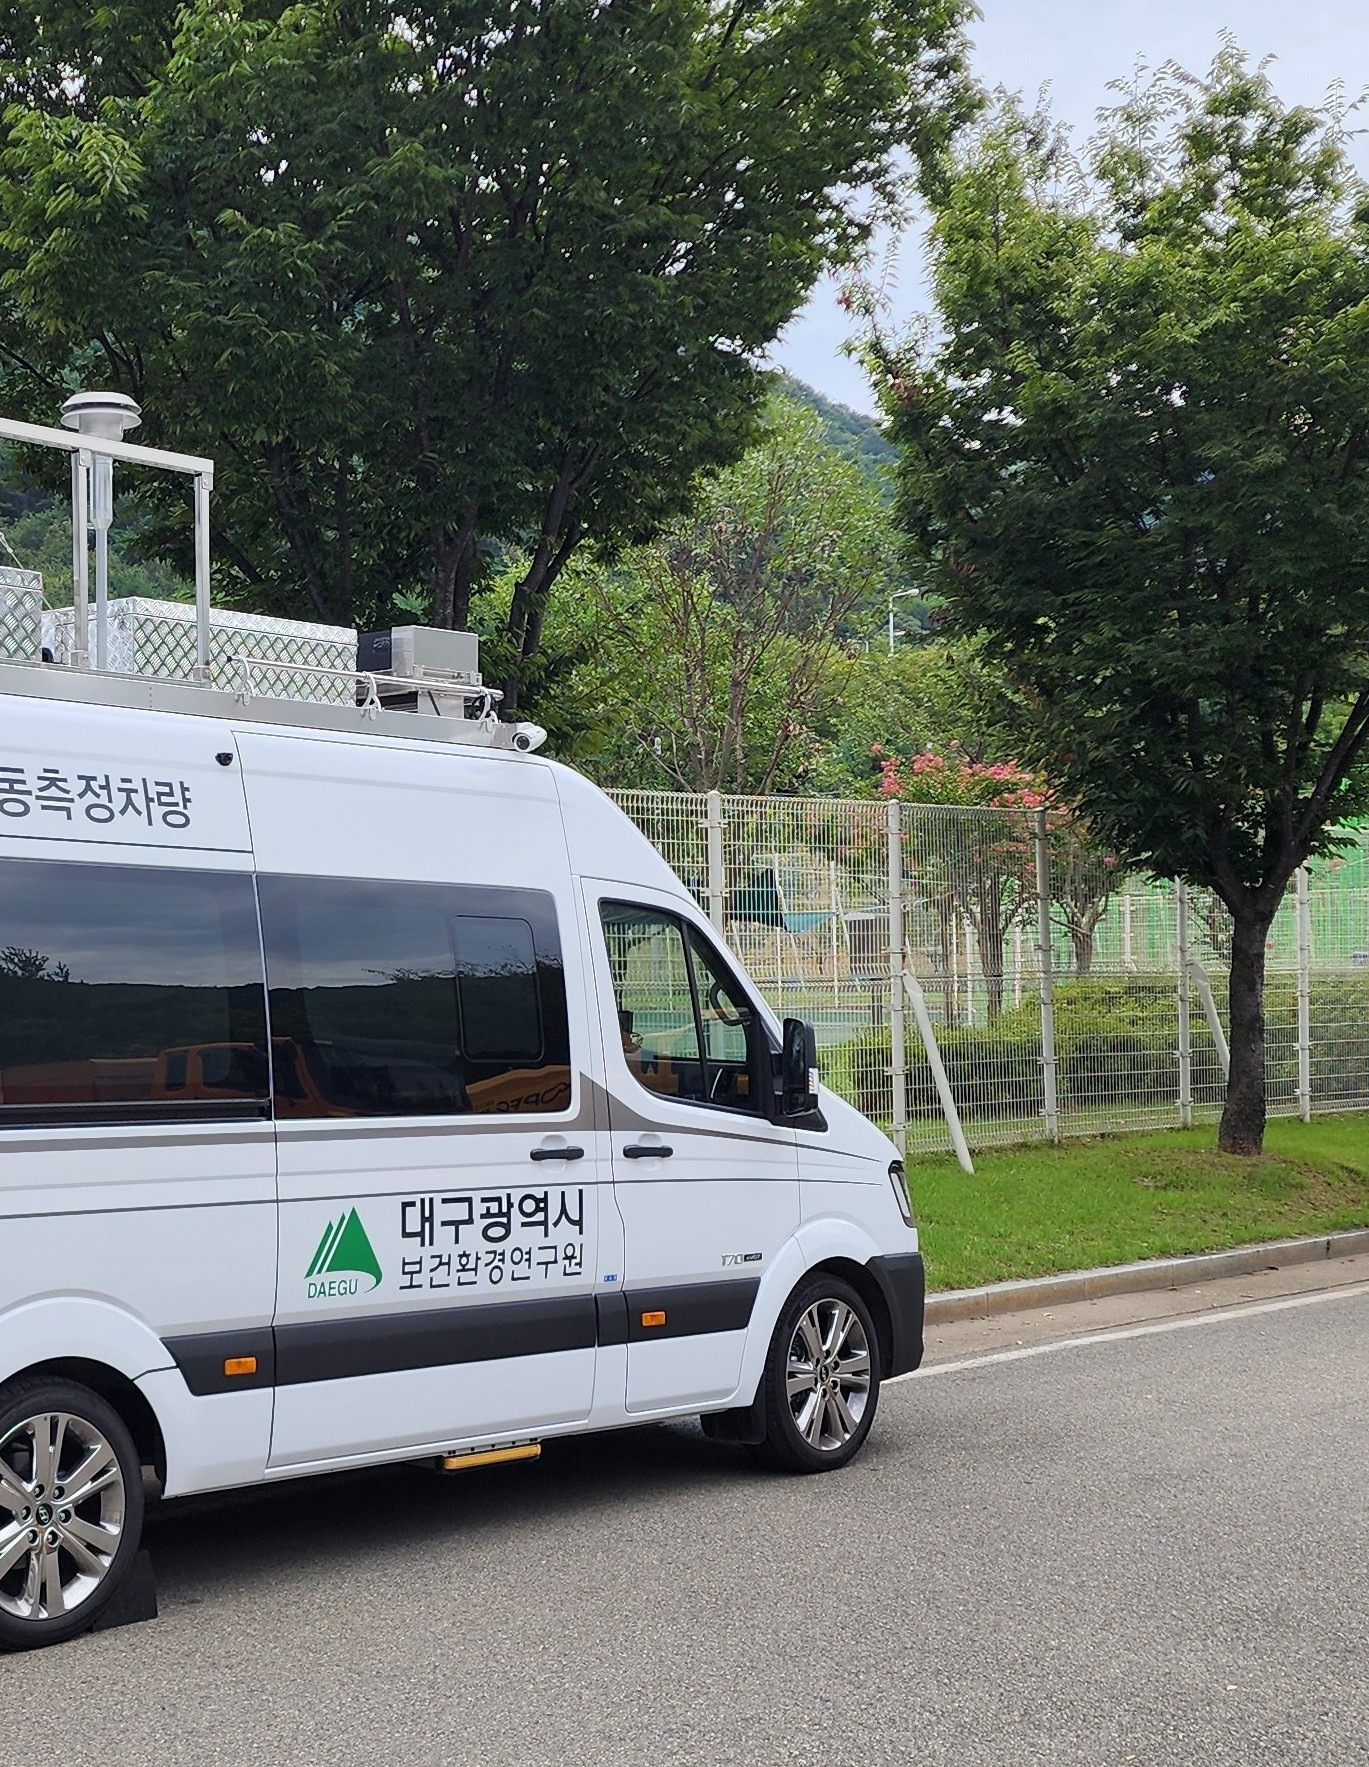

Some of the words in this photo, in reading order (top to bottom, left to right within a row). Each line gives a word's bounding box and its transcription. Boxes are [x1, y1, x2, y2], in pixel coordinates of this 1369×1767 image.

[399, 1188, 584, 1247] 대구광역시
[308, 1277, 358, 1299] DAEGU
[399, 1242, 583, 1291] 보건환경연구원
